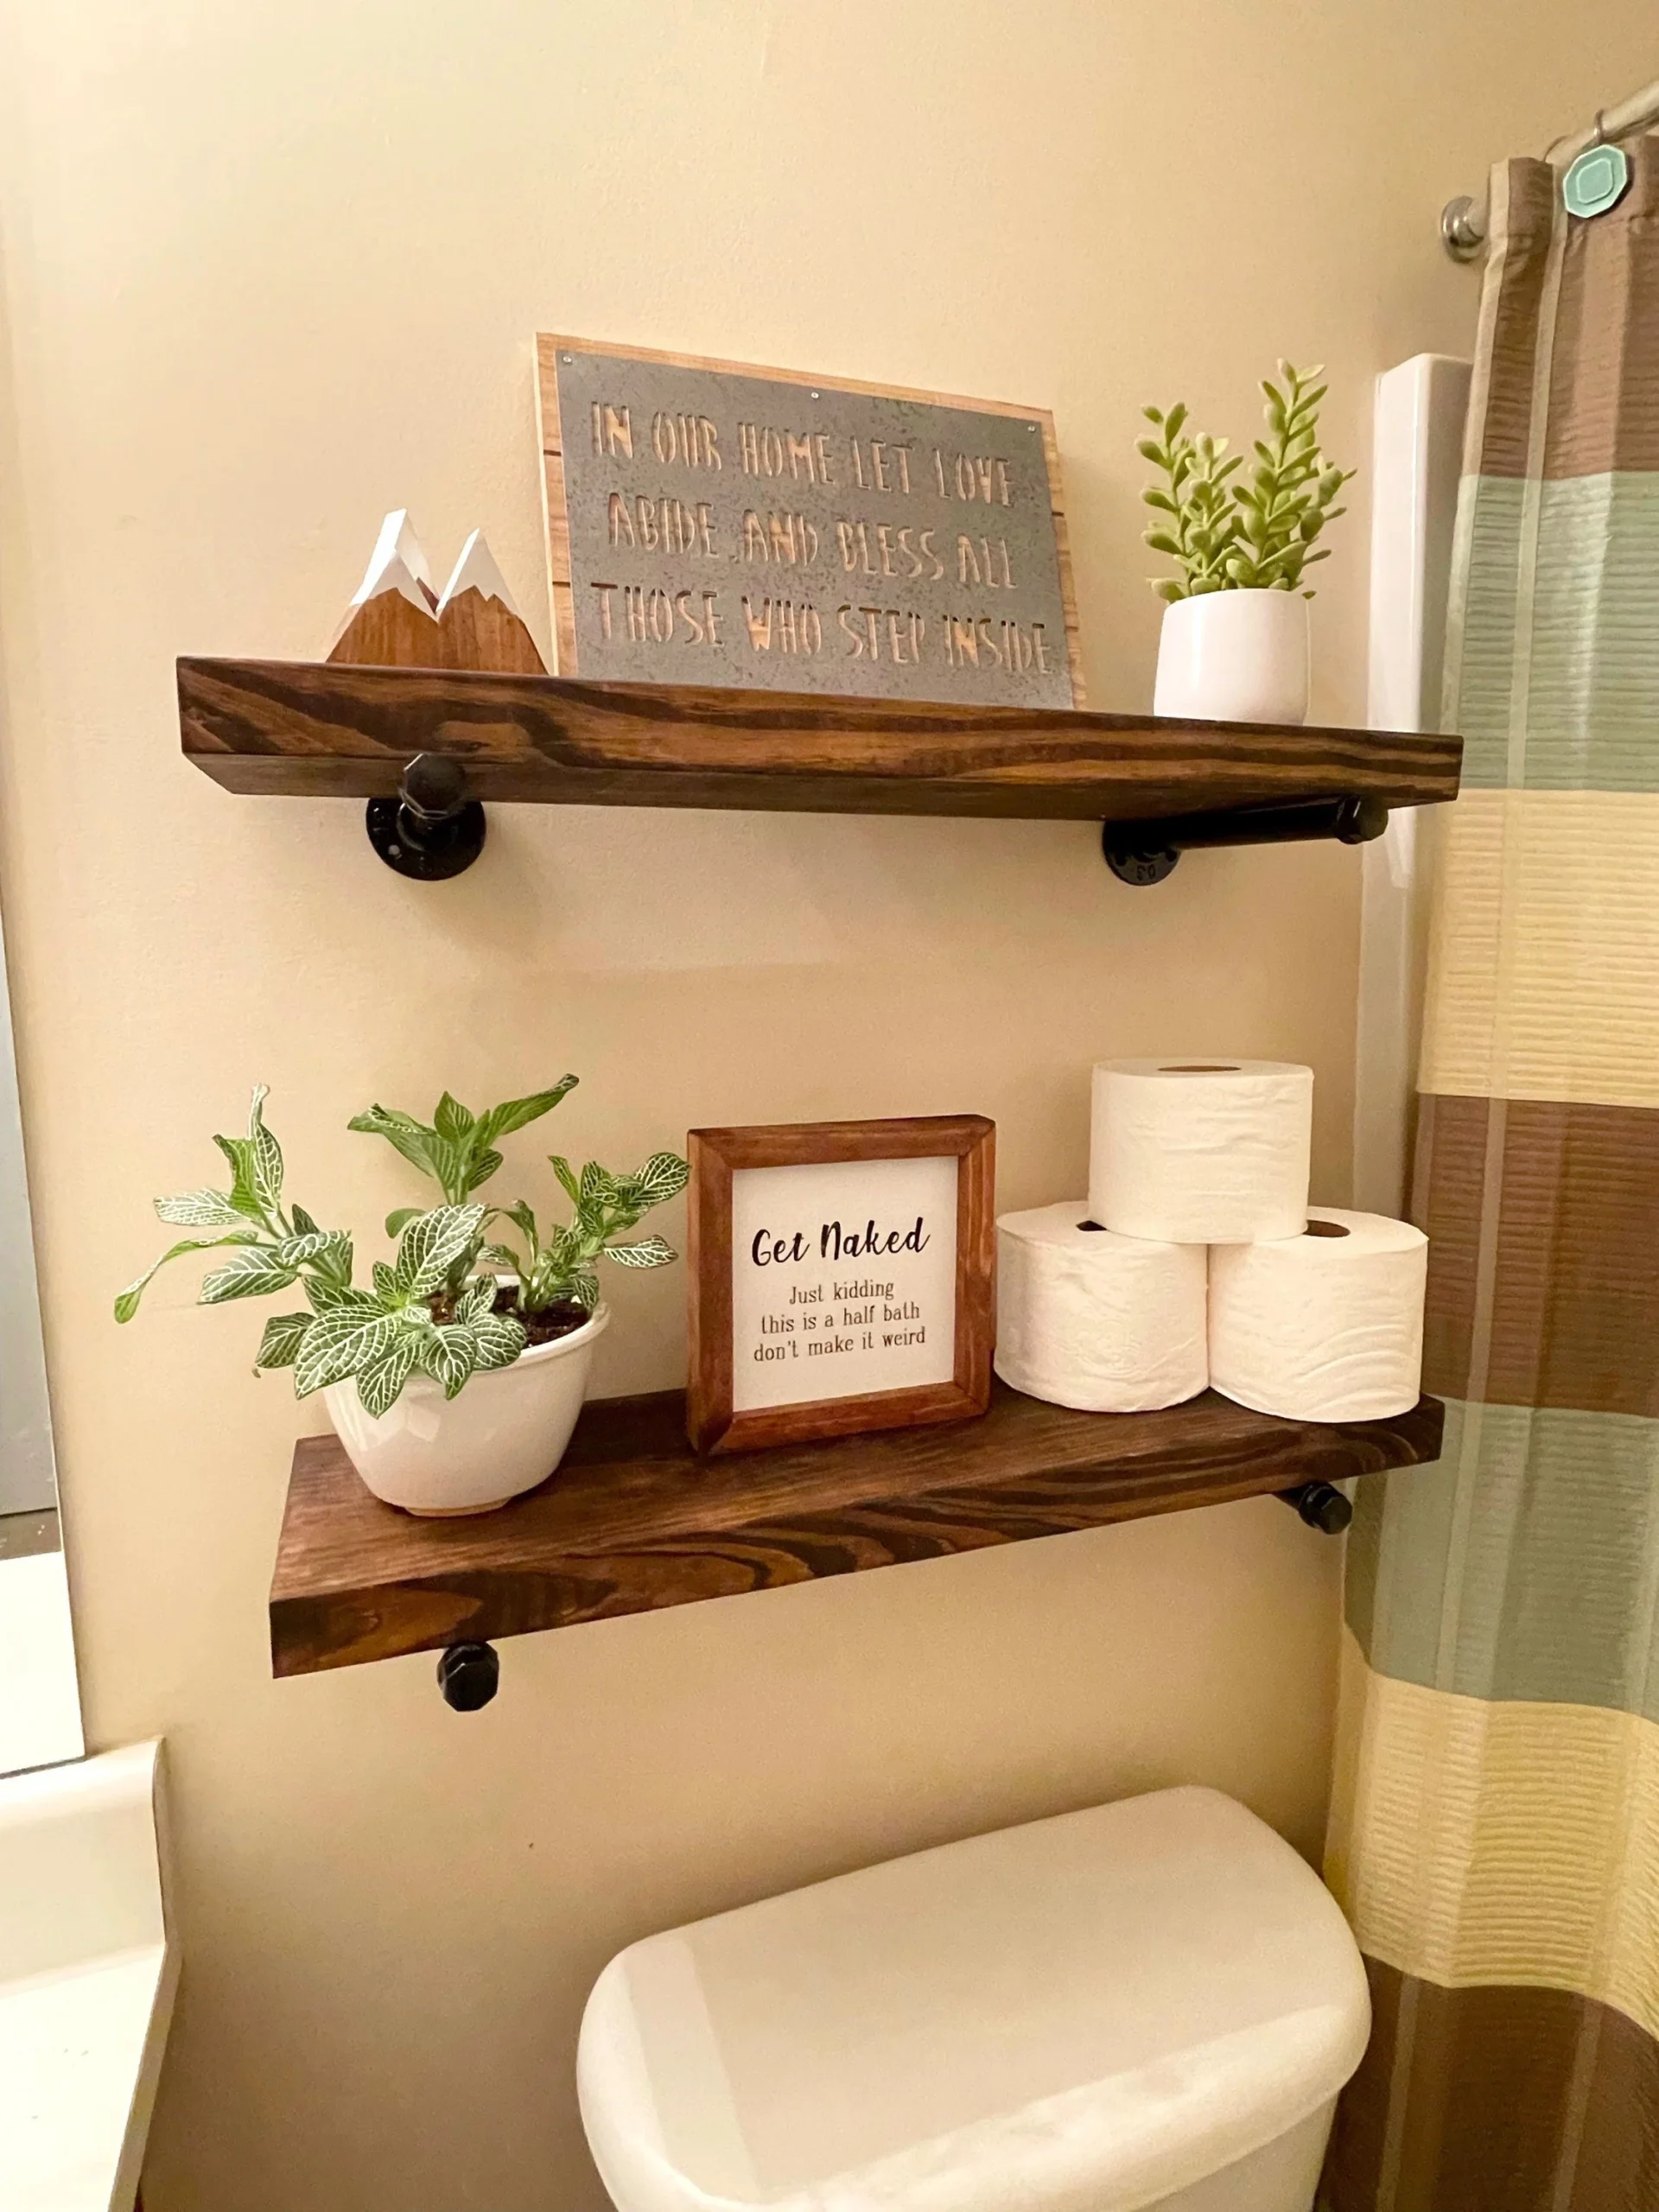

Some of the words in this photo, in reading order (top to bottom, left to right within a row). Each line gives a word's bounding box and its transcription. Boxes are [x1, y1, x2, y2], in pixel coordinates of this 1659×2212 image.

[591, 400, 633, 459] IN
[652, 411, 721, 471] OUR
[738, 421, 835, 485] HOME
[850, 435, 913, 493] LET
[932, 448, 1015, 507] LOVE
[608, 493, 720, 559] ABIDE
[743, 508, 818, 567] AND
[836, 518, 944, 582] BLESS
[957, 532, 1020, 589] ALL
[590, 582, 725, 648] THOSE
[741, 594, 822, 655] WHO
[837, 604, 925, 664] STEP
[942, 613, 1052, 674] INSIDE
[751, 1229, 810, 1267] Get
[820, 1217, 931, 1261] Naked
[789, 1283, 824, 1305] Just
[833, 1279, 895, 1300] kidding
[761, 1313, 795, 1335] this
[803, 1312, 817, 1331] is
[824, 1313, 834, 1327] a
[843, 1305, 875, 1326] half
[883, 1300, 921, 1322] bath
[753, 1339, 799, 1362] don't
[808, 1334, 855, 1357] make
[861, 1331, 874, 1350] it
[881, 1325, 926, 1348] weird
